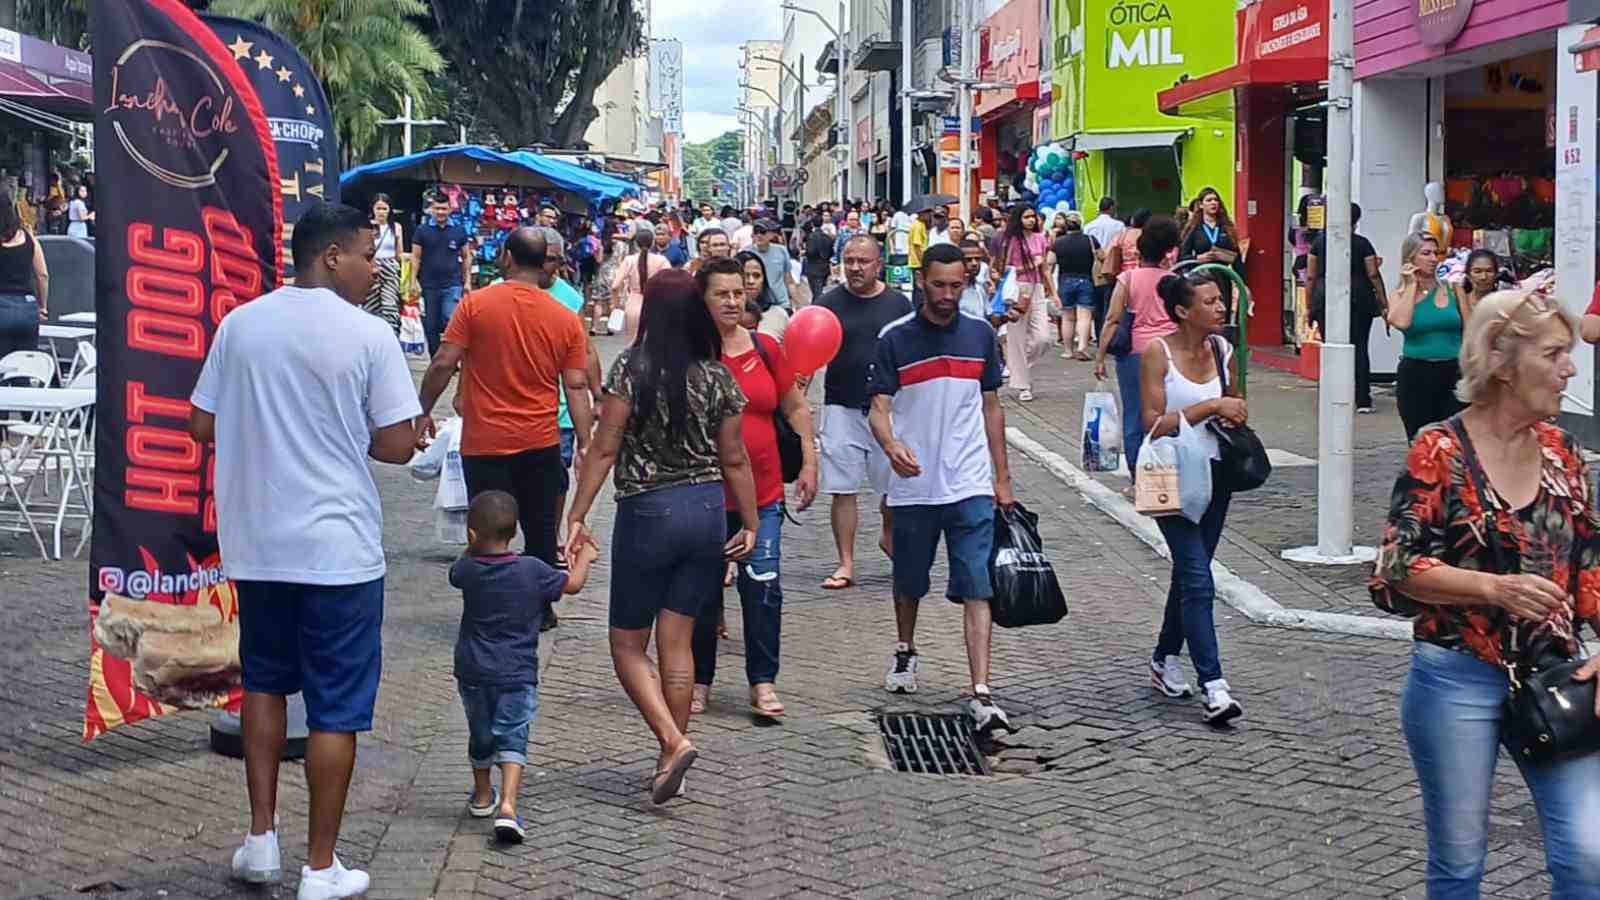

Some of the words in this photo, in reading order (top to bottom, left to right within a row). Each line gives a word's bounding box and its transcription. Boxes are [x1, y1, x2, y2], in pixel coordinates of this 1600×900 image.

[1107, 26, 1184, 68] MIL
[1110, 1, 1171, 25] ÓTICA
[127, 222, 205, 359] DOG
[125, 379, 203, 515] HOT
